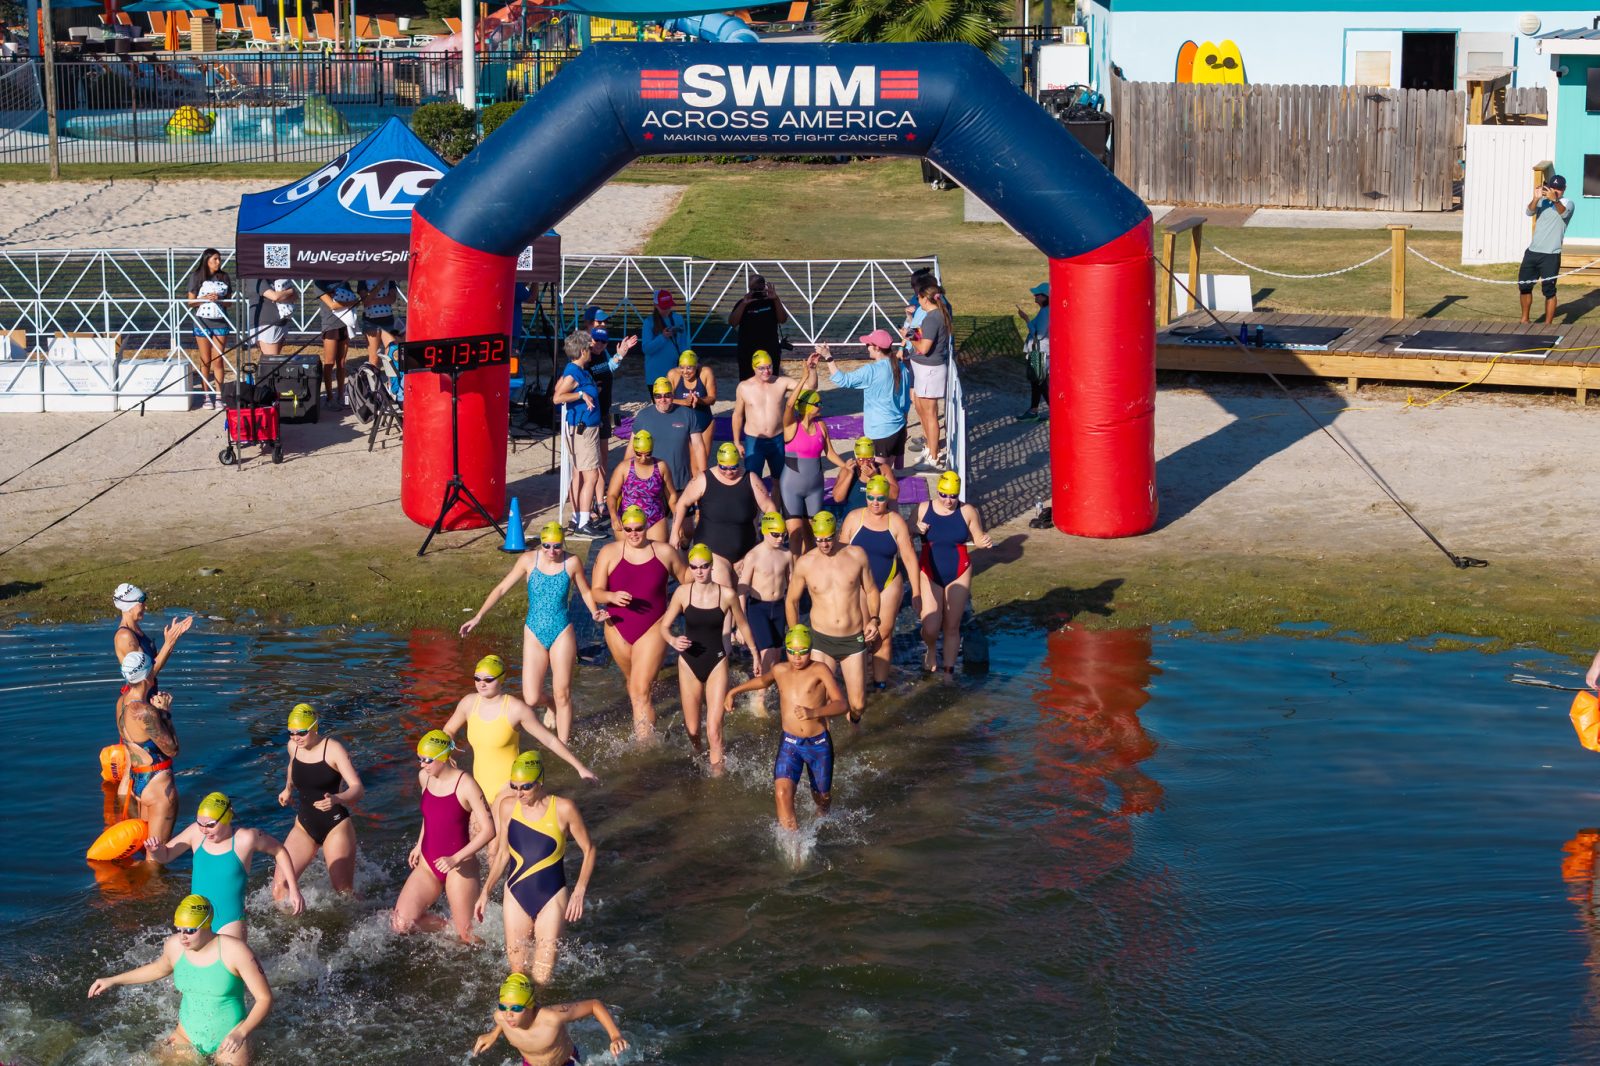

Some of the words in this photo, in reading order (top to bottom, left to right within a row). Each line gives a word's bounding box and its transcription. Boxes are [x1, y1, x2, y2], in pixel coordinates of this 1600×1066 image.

[681, 64, 876, 108] SWIM
[641, 110, 770, 129] ACROSS
[778, 110, 917, 129] AMERICA
[663, 133, 717, 142] MAKING
[720, 133, 767, 142] WAVES
[771, 133, 790, 142] TO
[794, 133, 840, 142] FIGHT
[842, 133, 898, 142] CANCER
[296, 250, 411, 264] MyNegativeSpli
